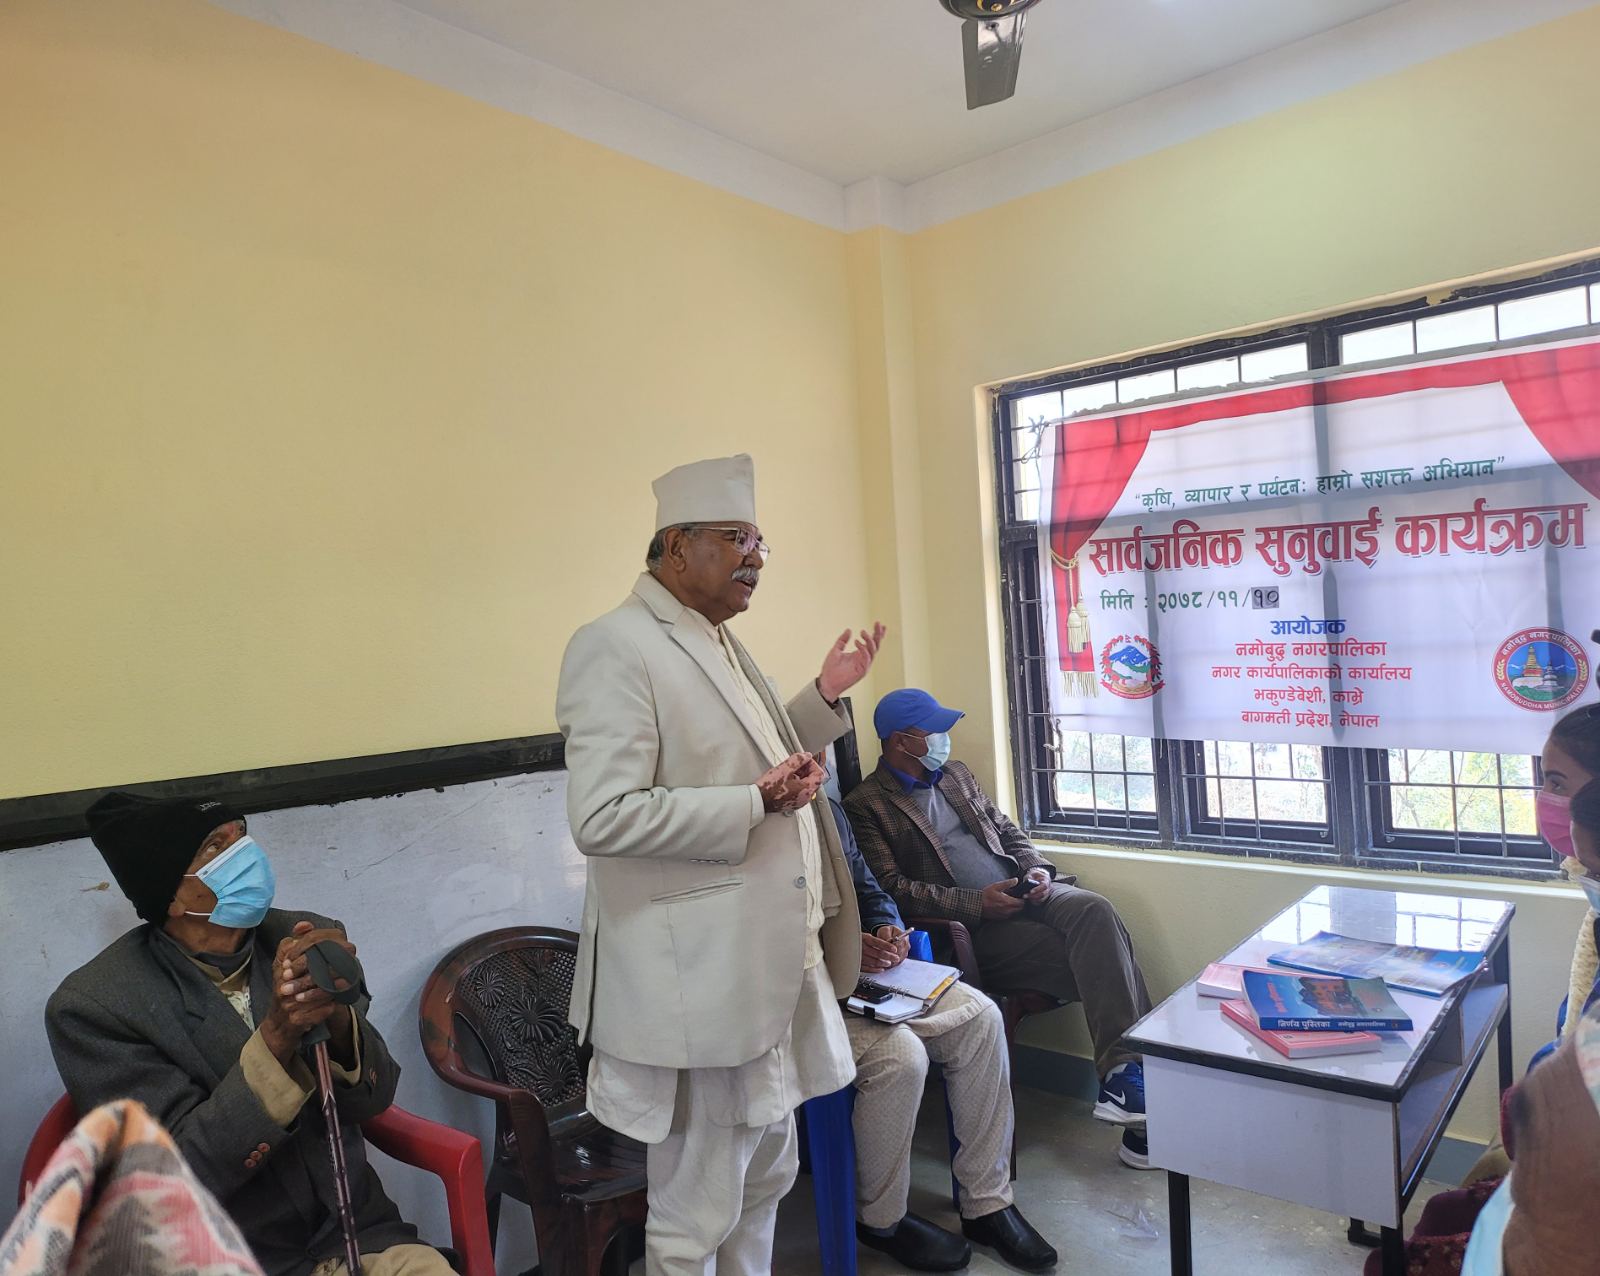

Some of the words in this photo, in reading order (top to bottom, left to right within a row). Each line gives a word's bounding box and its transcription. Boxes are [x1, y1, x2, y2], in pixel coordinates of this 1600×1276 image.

[1185, 486, 1233, 503] व्यापार
[1240, 484, 1252, 501] र
[1316, 469, 1352, 494] हाम्रो
[1360, 467, 1414, 490] सशक्त
[1088, 518, 1246, 577] सार्वजनिक
[1255, 506, 1383, 577] सुनुवाई
[1394, 497, 1590, 558] कार्यक्रम
[1100, 588, 1135, 610] मिति
[1270, 615, 1347, 635] आयोजक
[1291, 637, 1388, 657] नगरपालिका
[1211, 666, 1242, 679] नगर
[1246, 662, 1343, 680] कार्यपालिकाको
[1347, 663, 1413, 681] कार्यालय
[1332, 686, 1364, 706] काभ्रे
[1501, 682, 1542, 709] NAMOBUDDHA
[1543, 684, 1585, 710] MUNICIPALITY
[1295, 709, 1333, 728] प्रदेश,
[1338, 710, 1380, 728] नेपाल
